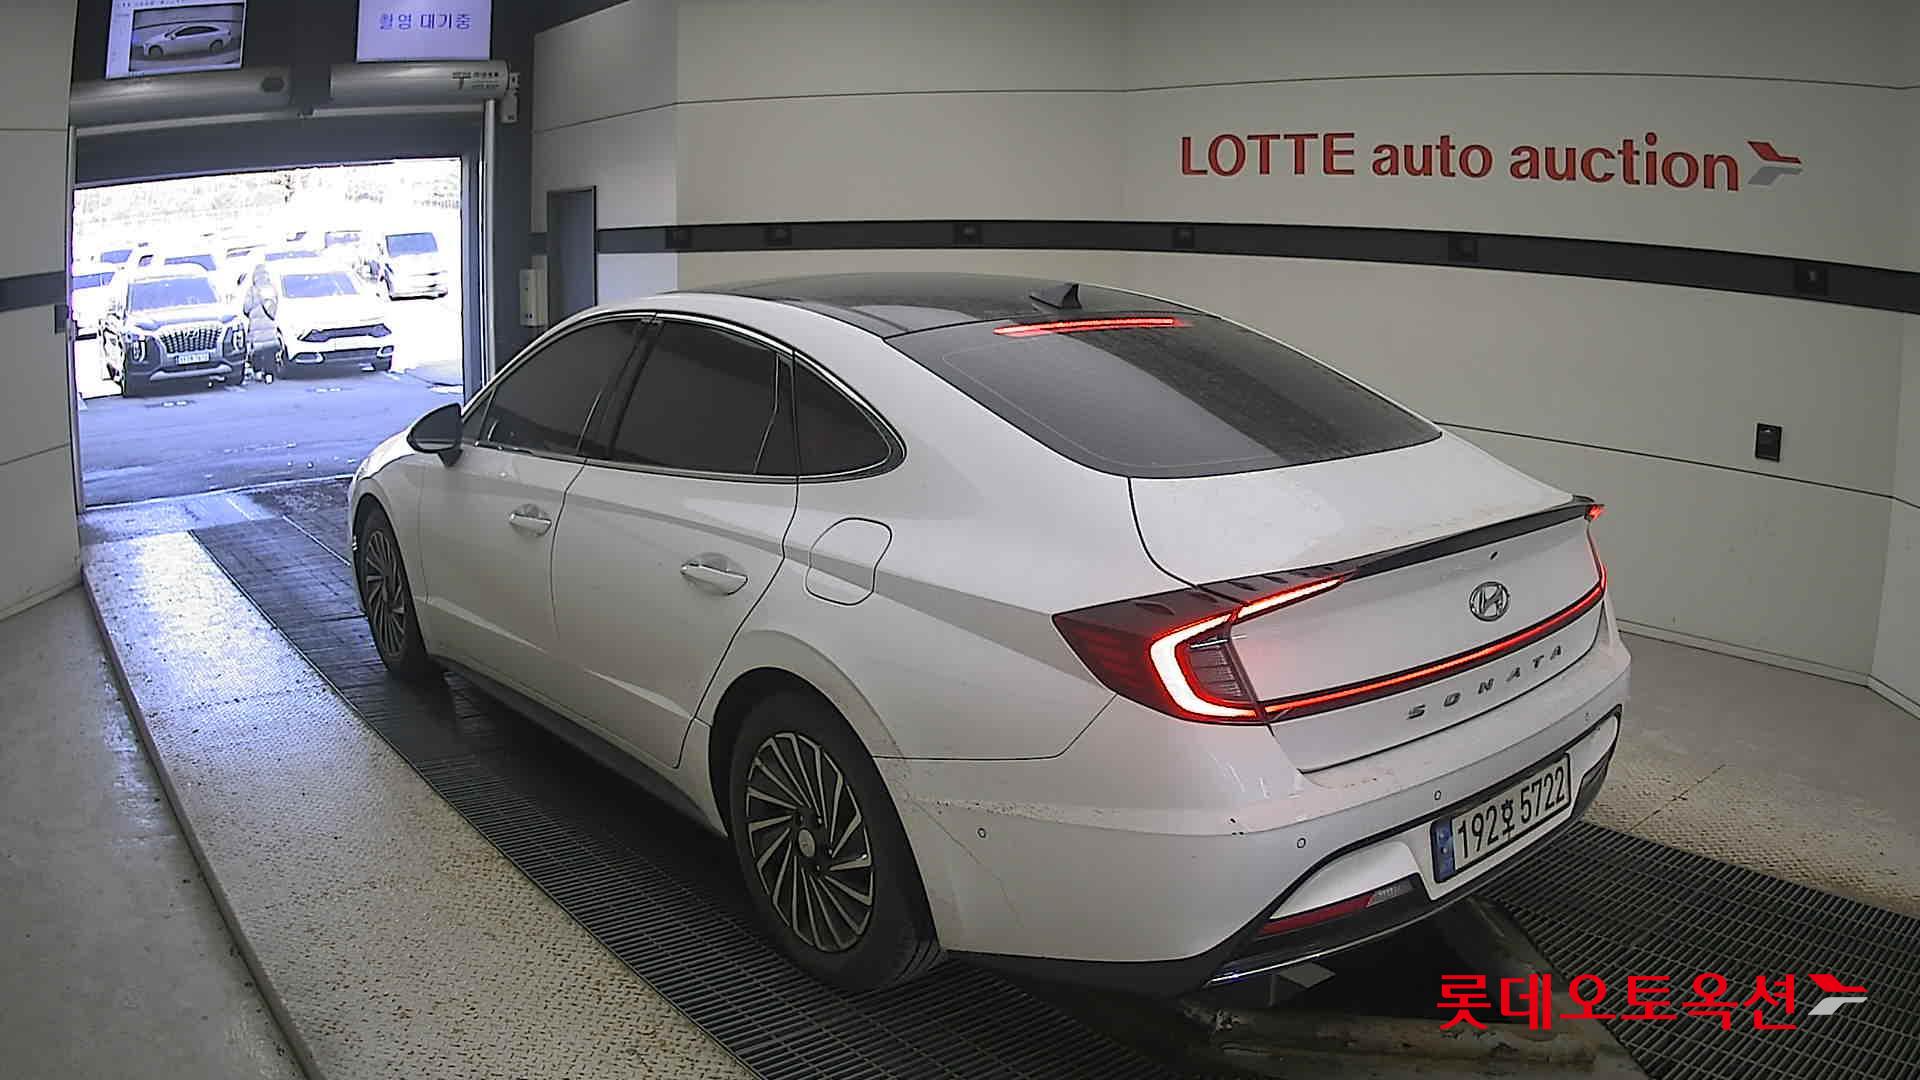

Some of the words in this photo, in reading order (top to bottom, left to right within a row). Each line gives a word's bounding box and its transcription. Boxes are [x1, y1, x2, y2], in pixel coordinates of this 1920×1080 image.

[419, 13, 472, 30] 대기중
[1181, 132, 1356, 176] LOTTE
[1371, 134, 1494, 178] auto
[1509, 131, 1740, 192] auction
[1406, 645, 1562, 720] SONATA
